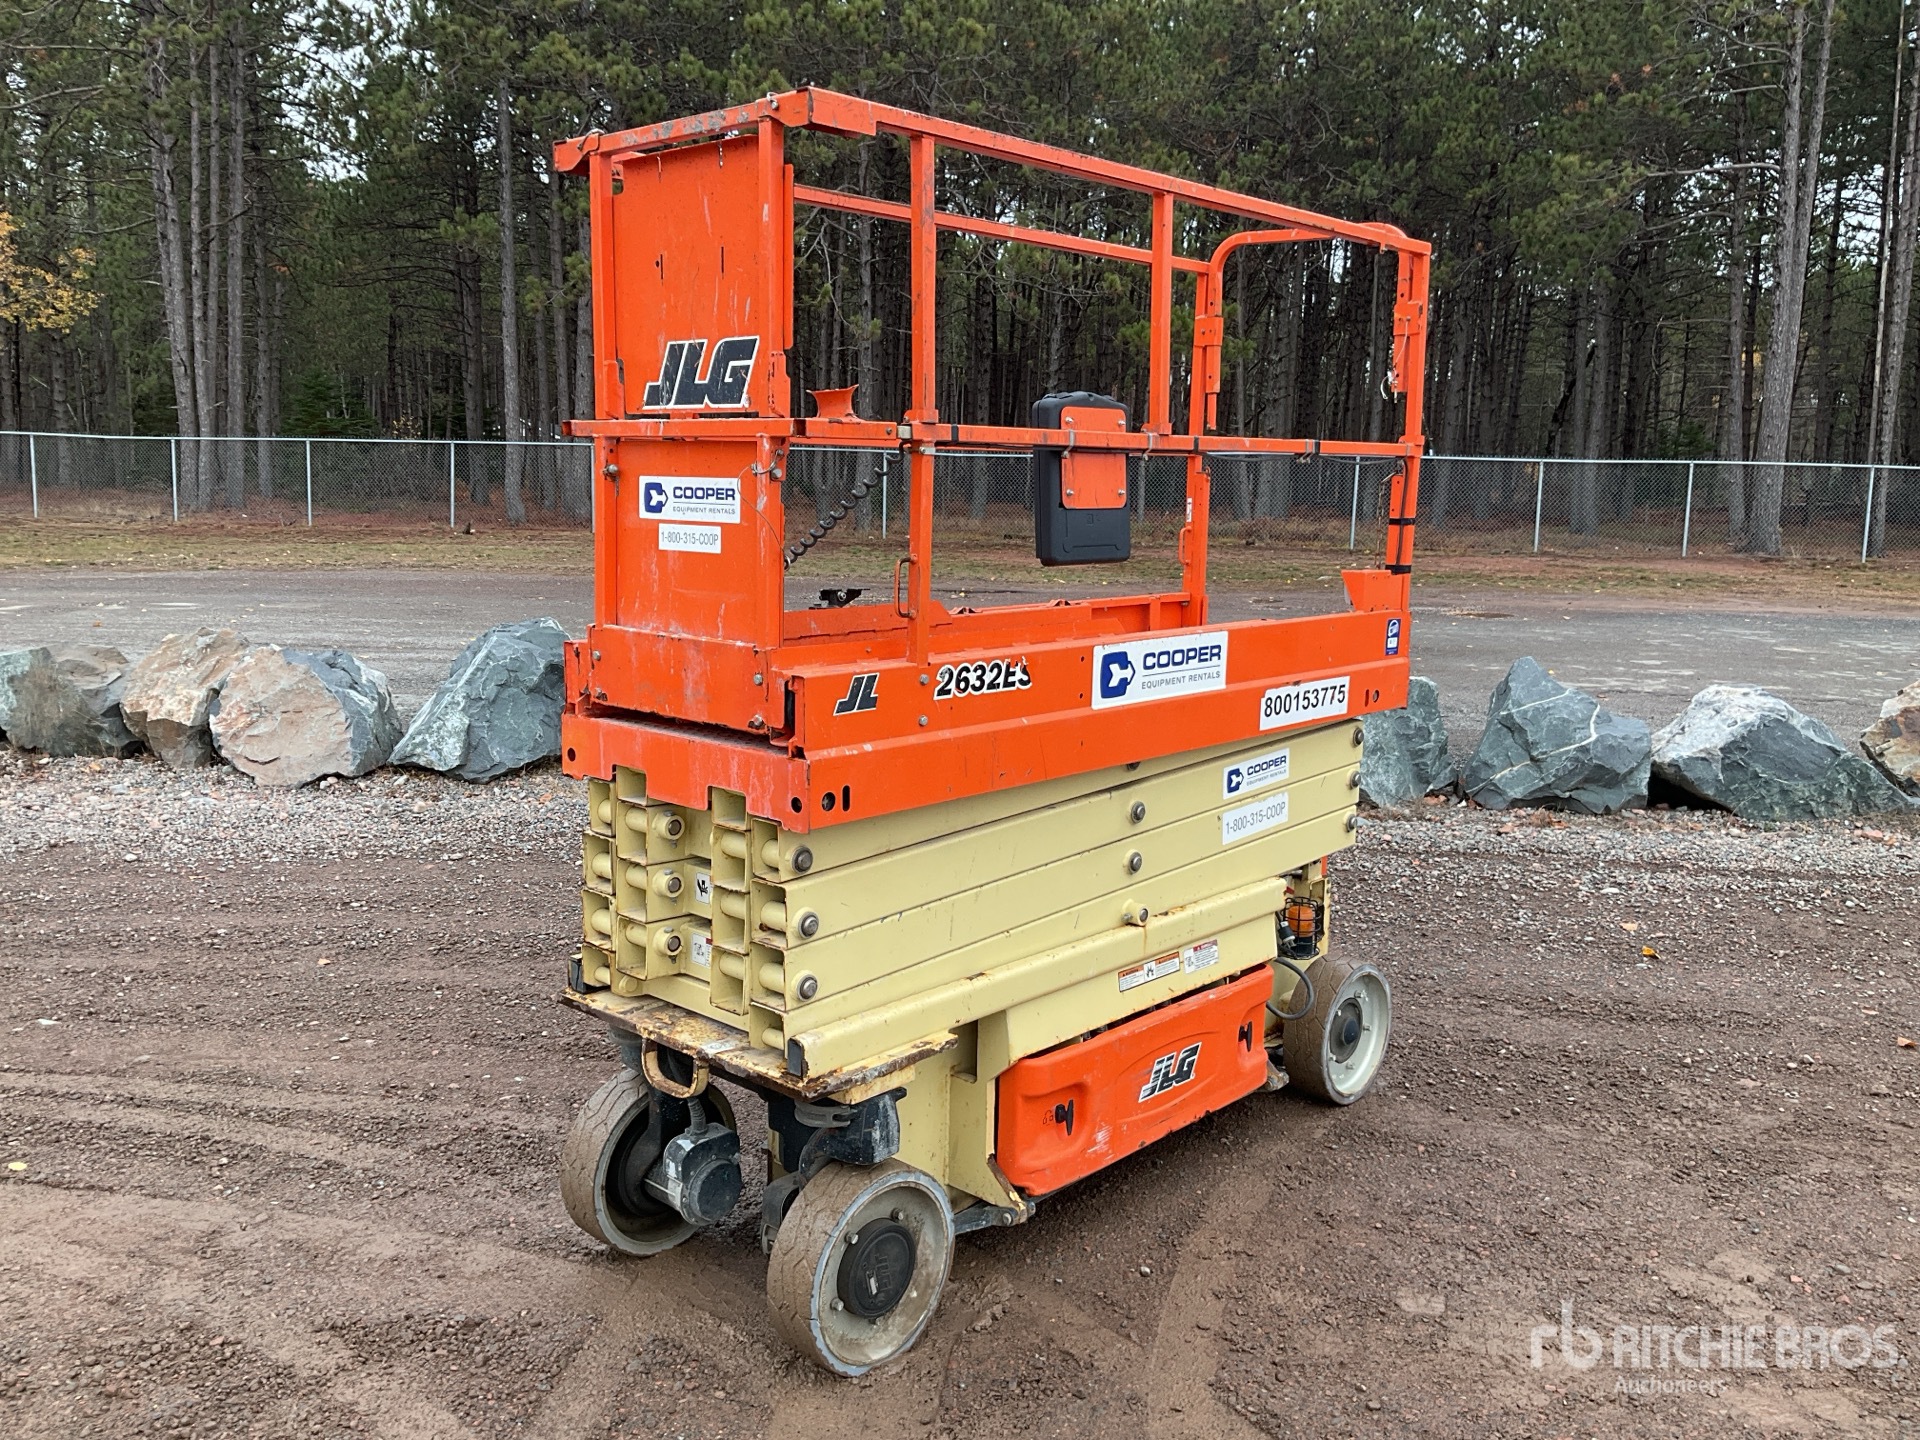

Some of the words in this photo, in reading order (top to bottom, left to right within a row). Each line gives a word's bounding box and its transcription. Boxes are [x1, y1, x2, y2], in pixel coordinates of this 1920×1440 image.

[642, 335, 760, 410] JLG
[673, 486, 736, 501] COOPER
[672, 506, 707, 514] EQUIPMENT
[708, 507, 736, 515] RENTALS
[661, 531, 719, 546] 1-800-315-COOP
[1142, 644, 1222, 671] COOPER
[1141, 675, 1187, 689] EQUIPMENT
[1188, 670, 1221, 683] RENTALS
[1264, 684, 1346, 718] 800153775
[1246, 755, 1287, 776] COOPER
[1226, 801, 1286, 835] 1-800-315-COOP
[1138, 1041, 1202, 1103] JLG
